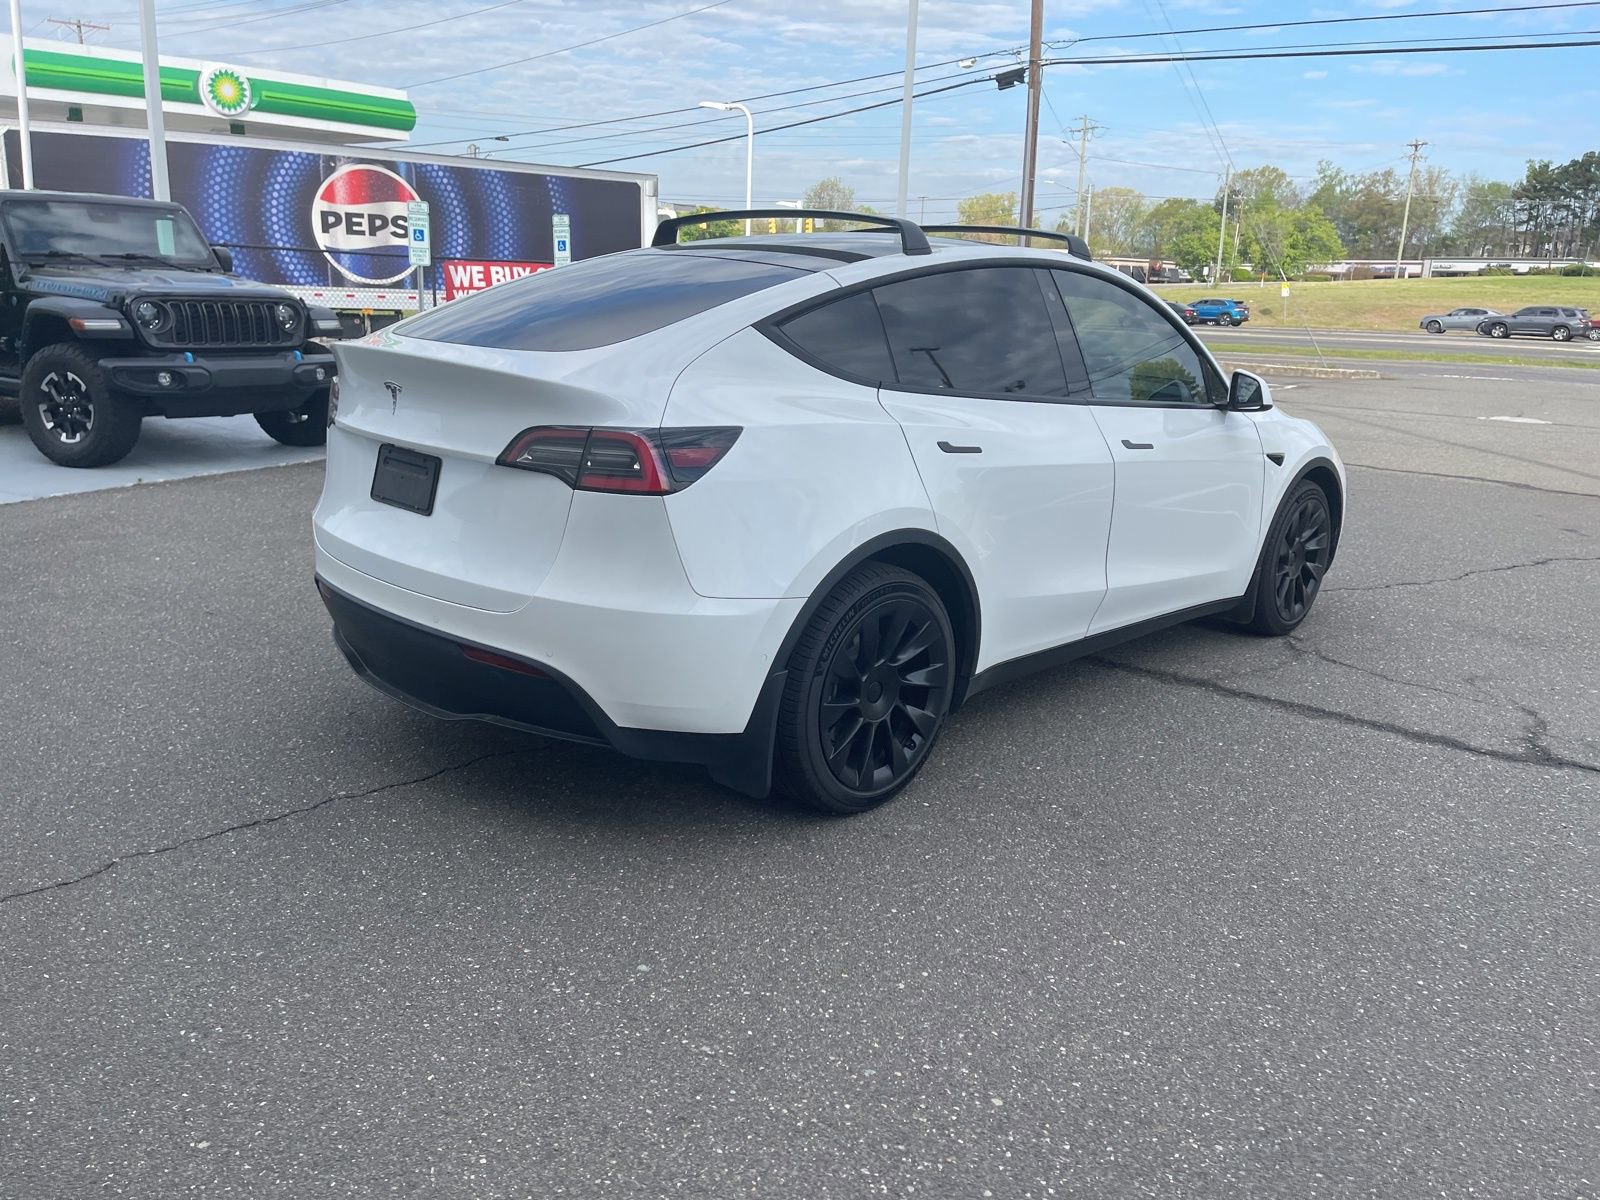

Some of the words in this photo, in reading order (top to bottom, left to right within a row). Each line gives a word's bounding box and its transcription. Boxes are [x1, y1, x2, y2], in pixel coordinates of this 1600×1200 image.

[320, 210, 408, 239] PEPS
[448, 265, 486, 287] WE
[822, 608, 856, 659] MICHELIN
